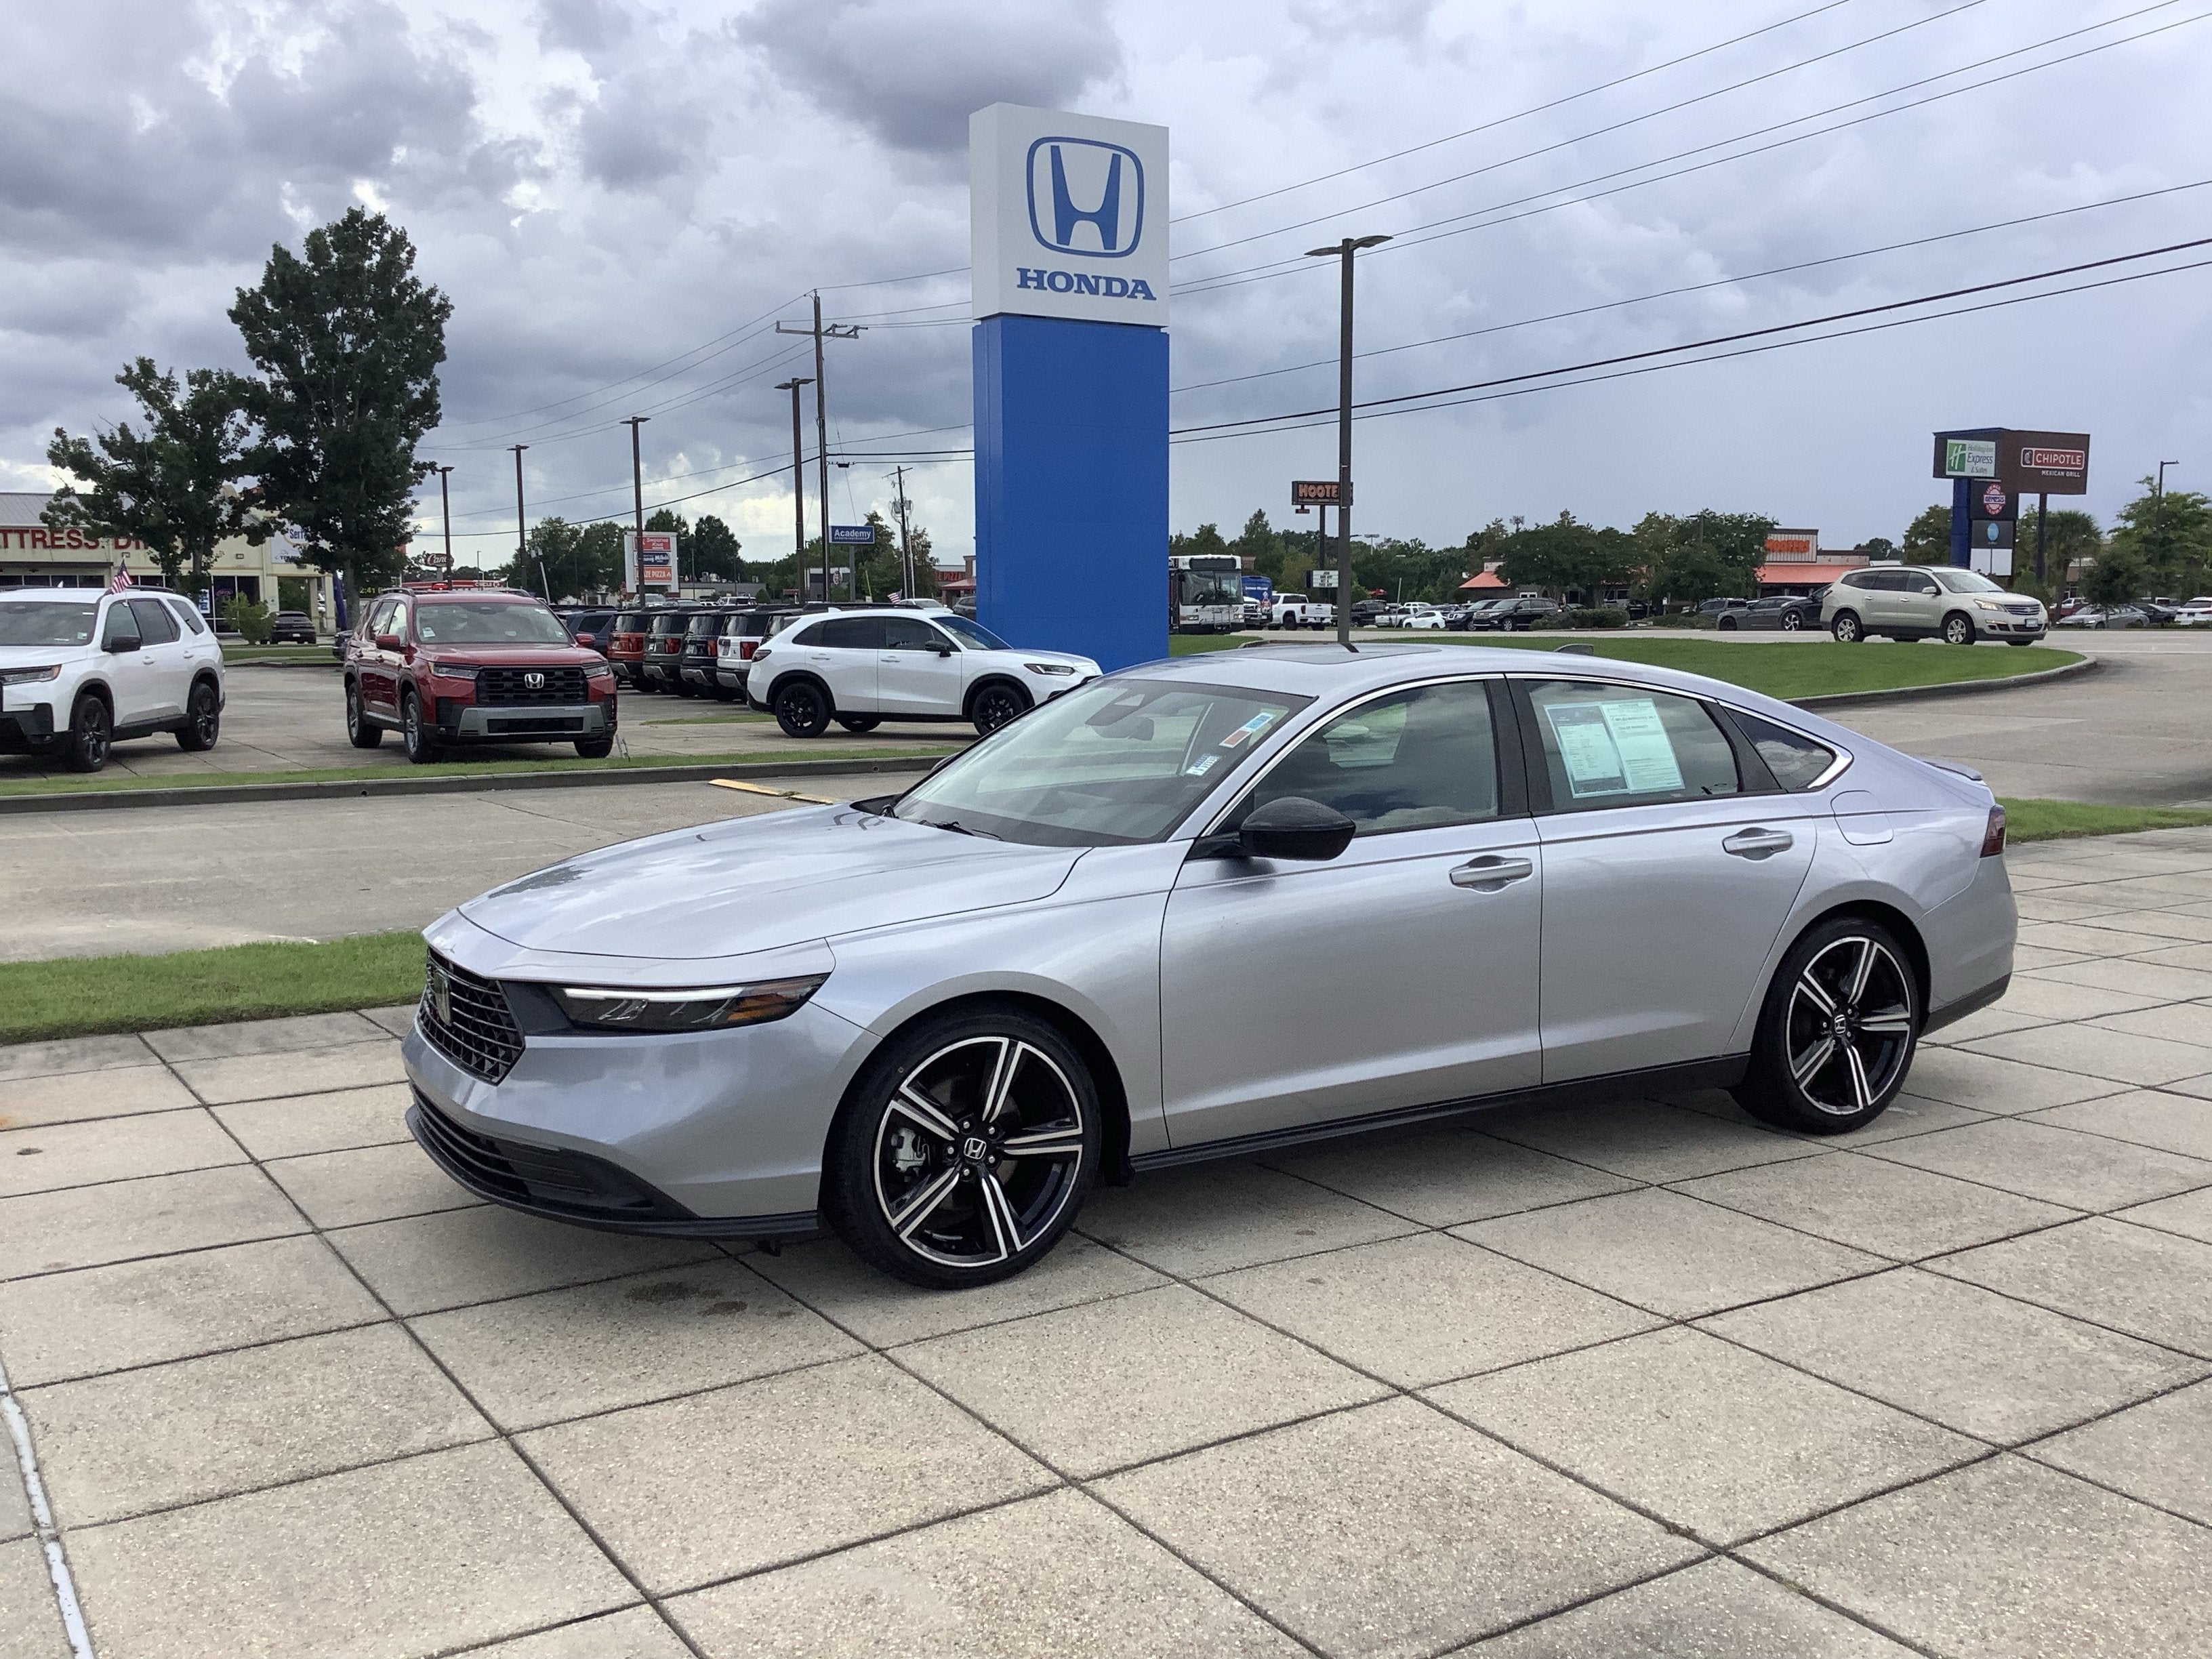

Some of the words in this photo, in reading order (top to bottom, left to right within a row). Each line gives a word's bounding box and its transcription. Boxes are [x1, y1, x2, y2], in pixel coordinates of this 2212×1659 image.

[1017, 268, 1157, 300] HONDA
[1967, 452, 1993, 465] Express
[2036, 453, 2083, 465] CHIPOTLE
[1298, 483, 1340, 498] HOOTE
[834, 529, 872, 539] Academy
